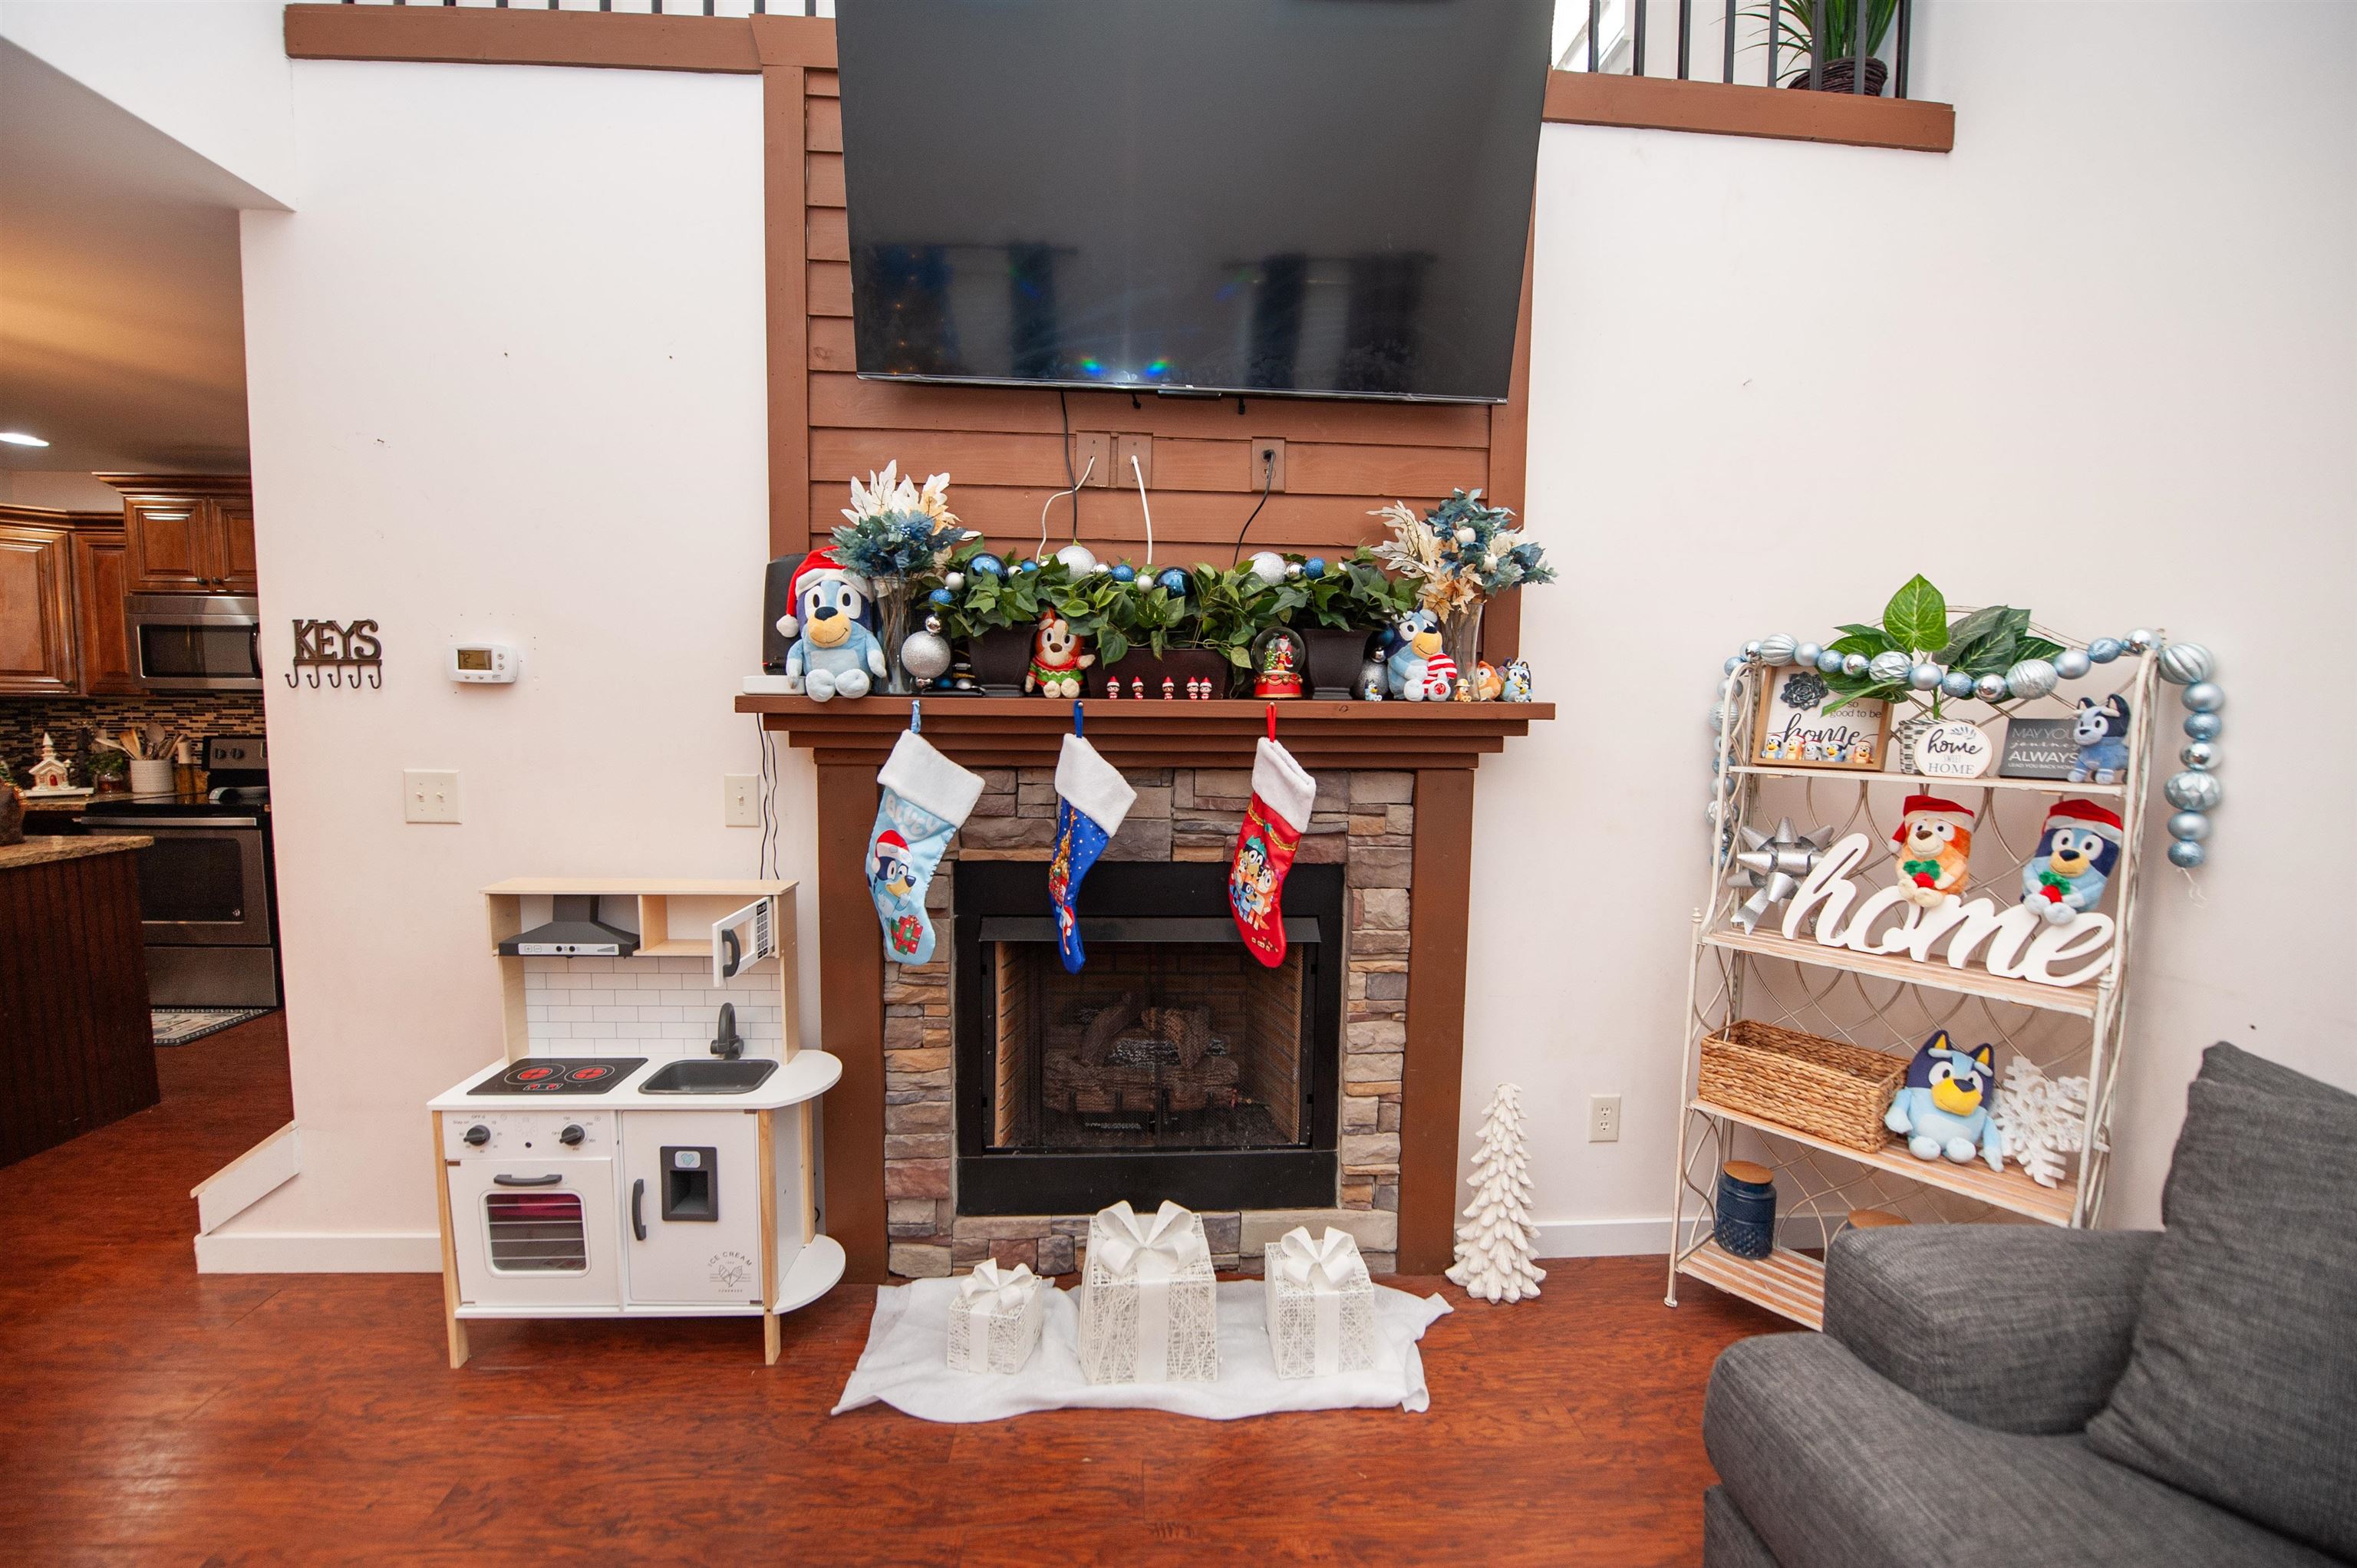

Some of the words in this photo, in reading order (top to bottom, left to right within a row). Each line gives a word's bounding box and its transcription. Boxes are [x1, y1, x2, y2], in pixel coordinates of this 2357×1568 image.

[292, 618, 382, 660] KEYS
[1829, 709, 1854, 718] good
[1868, 709, 1883, 718] be
[1782, 712, 1861, 750] home
[2012, 727, 2043, 738] MAY
[1927, 728, 1983, 755] home
[2008, 750, 2079, 765] ALWAYS
[1928, 763, 1975, 775] HOME
[1782, 832, 2115, 988] home
[707, 1254, 720, 1267] ICE
[722, 1251, 753, 1267] CREAM
